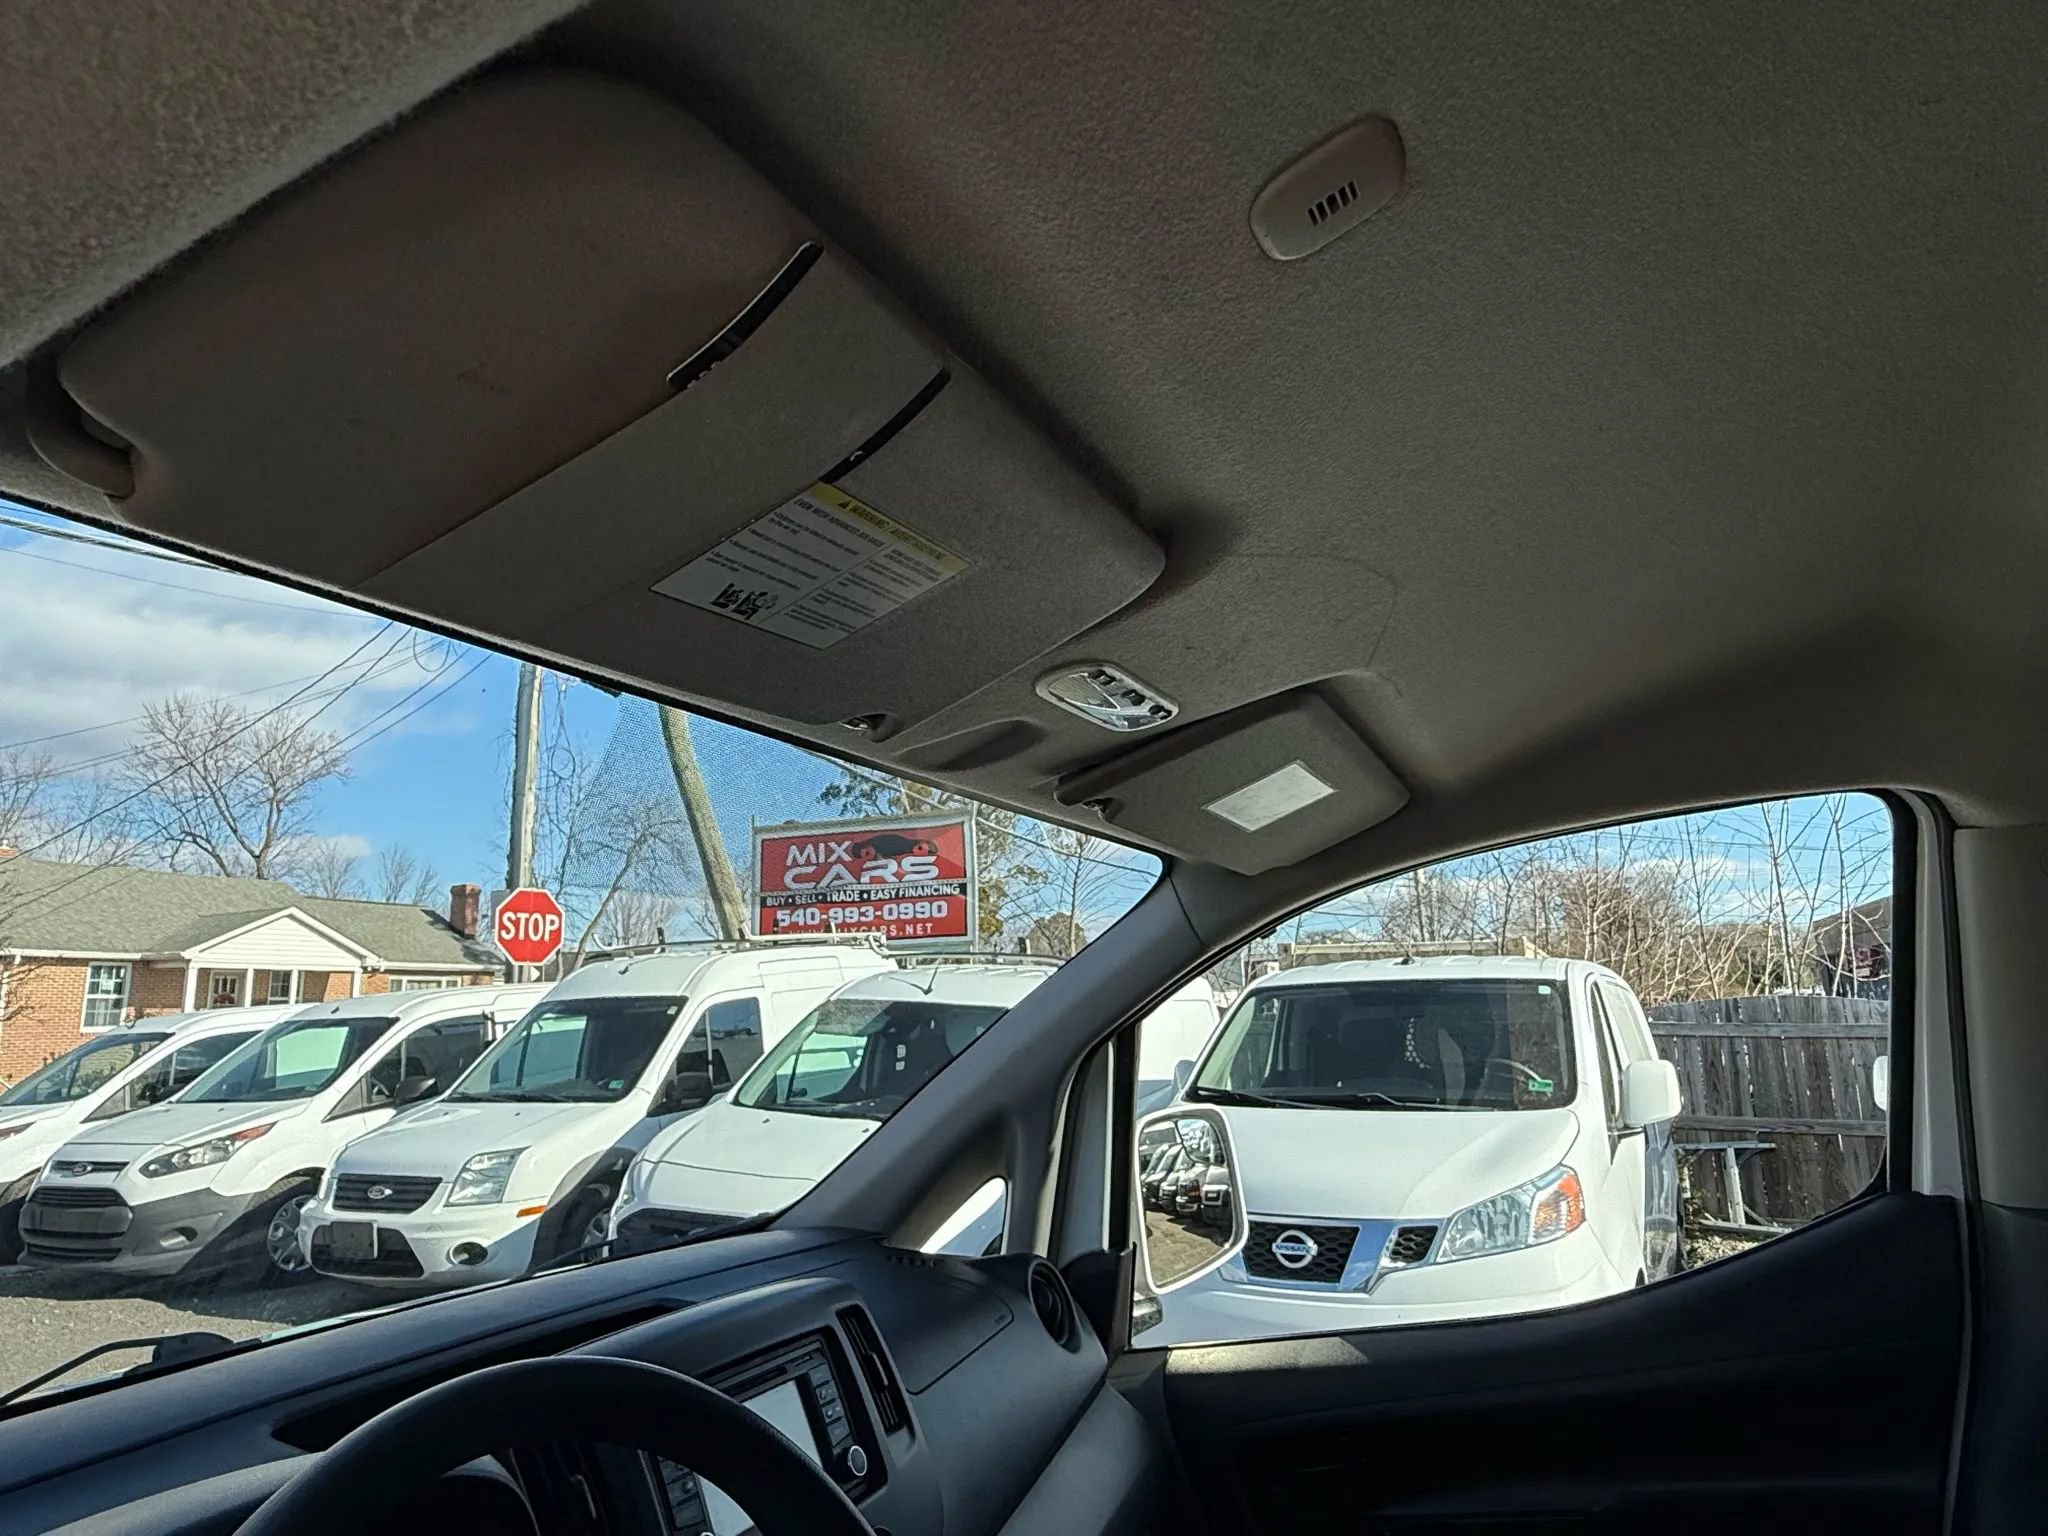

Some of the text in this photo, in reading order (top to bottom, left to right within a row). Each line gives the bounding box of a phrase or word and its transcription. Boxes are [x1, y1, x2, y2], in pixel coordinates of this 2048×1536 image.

[785, 840, 853, 866] MIX
[783, 855, 939, 890] CARS
[766, 884, 960, 906] BUY SELL TRADE EASY FINANCING
[501, 911, 560, 943] STOP
[776, 900, 948, 927] 540-993-0990
